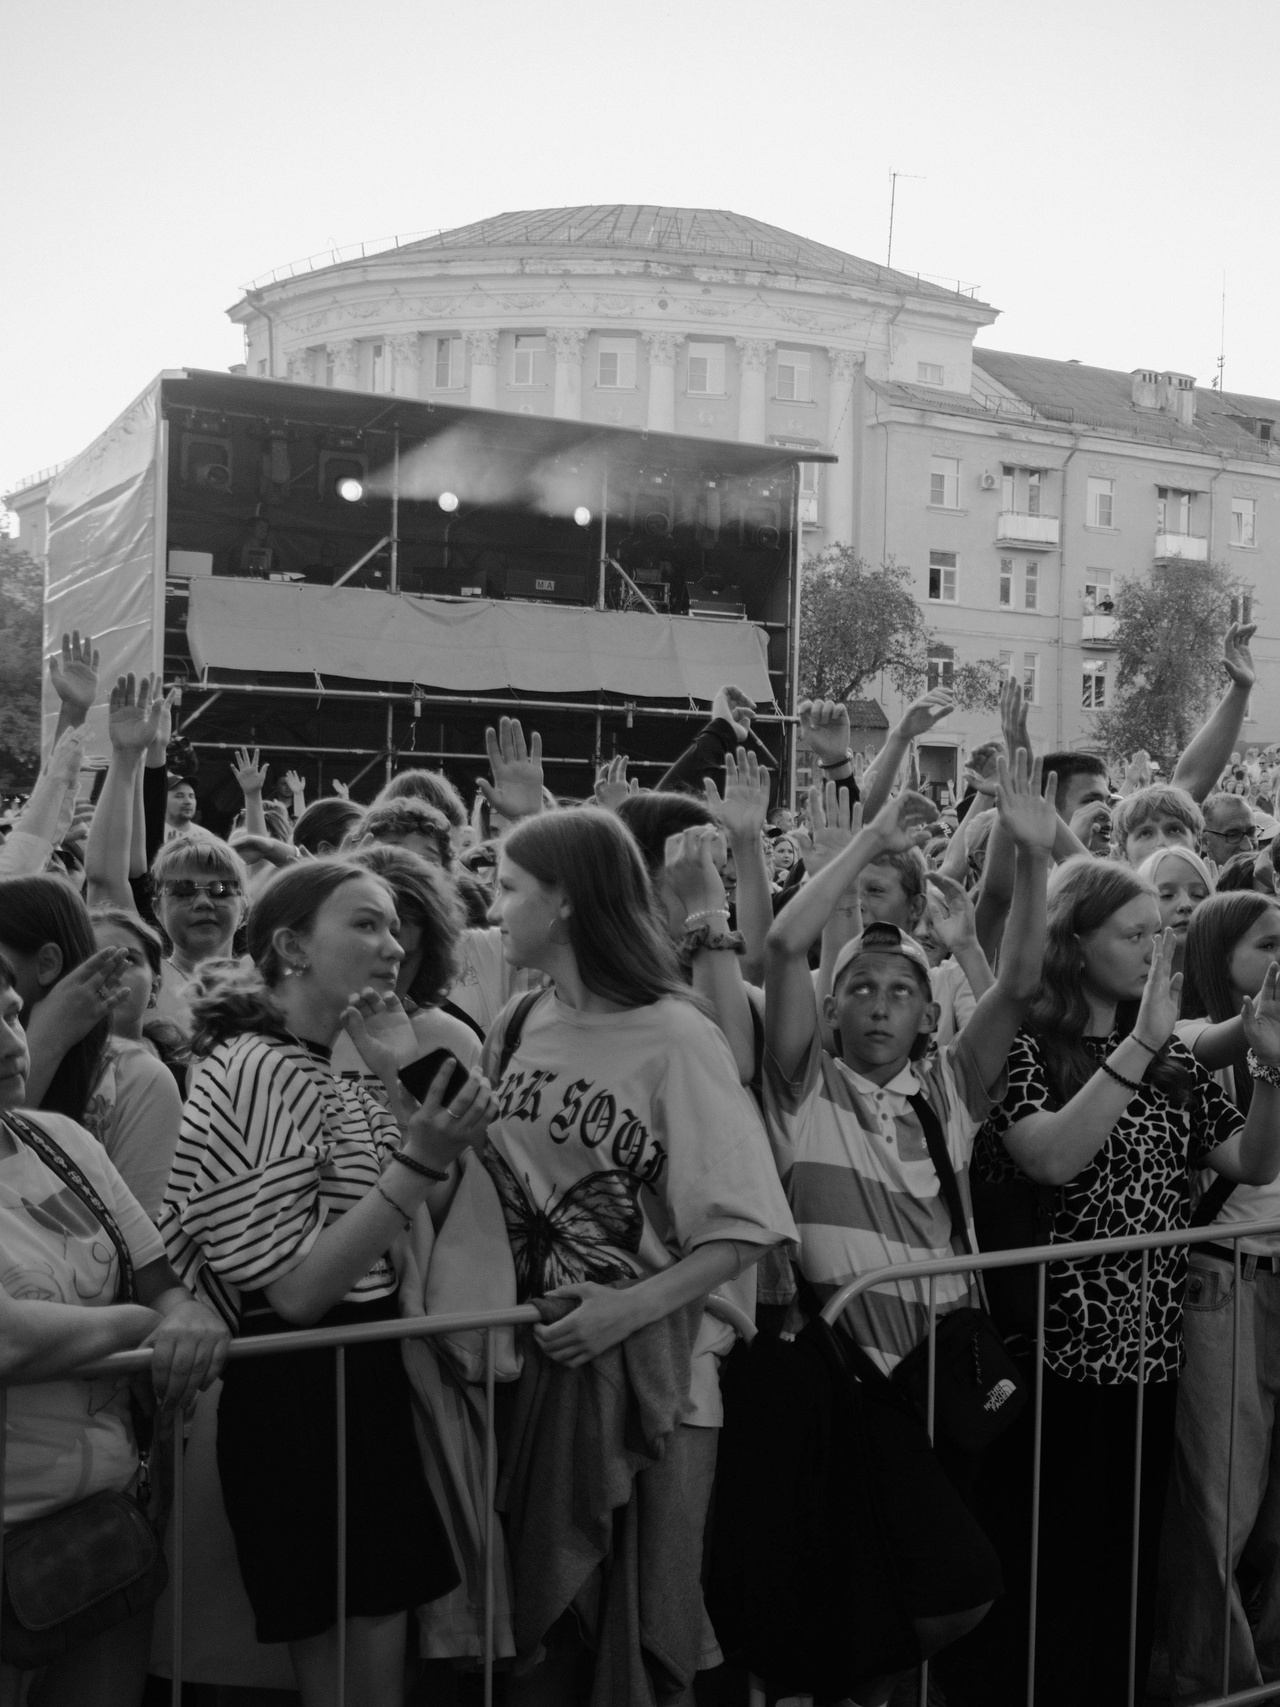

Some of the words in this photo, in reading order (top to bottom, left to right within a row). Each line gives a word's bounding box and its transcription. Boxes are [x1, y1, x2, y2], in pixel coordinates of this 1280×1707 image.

[498, 1069, 559, 1122] RK
[983, 1388, 1005, 1411] NORTH
[986, 1383, 1002, 1398] THE
[991, 1393, 1009, 1412] FACE
